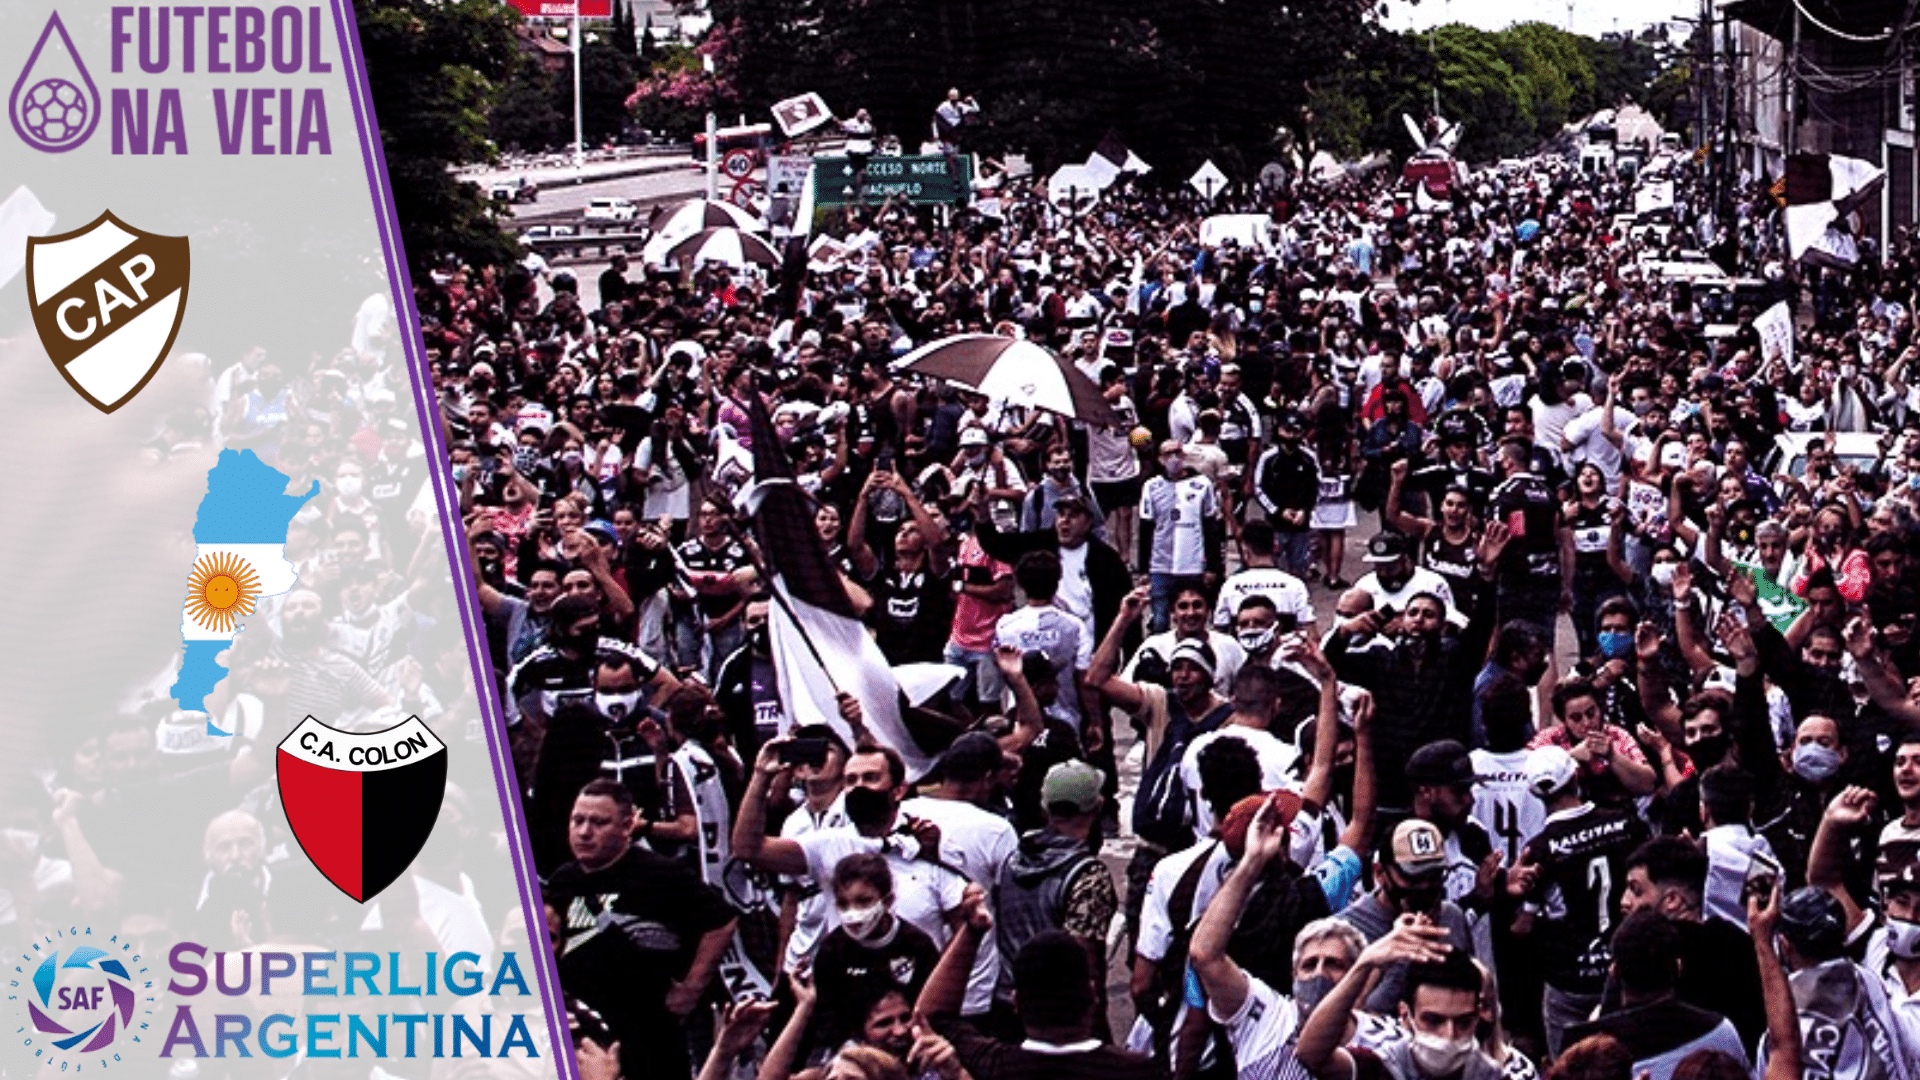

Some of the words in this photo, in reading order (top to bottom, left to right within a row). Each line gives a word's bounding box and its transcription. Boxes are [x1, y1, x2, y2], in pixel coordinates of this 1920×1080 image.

[729, 158, 747, 172] 40
[866, 162, 904, 176] CCESO
[911, 161, 947, 175] NORTE
[1493, 798, 1524, 868] 4
